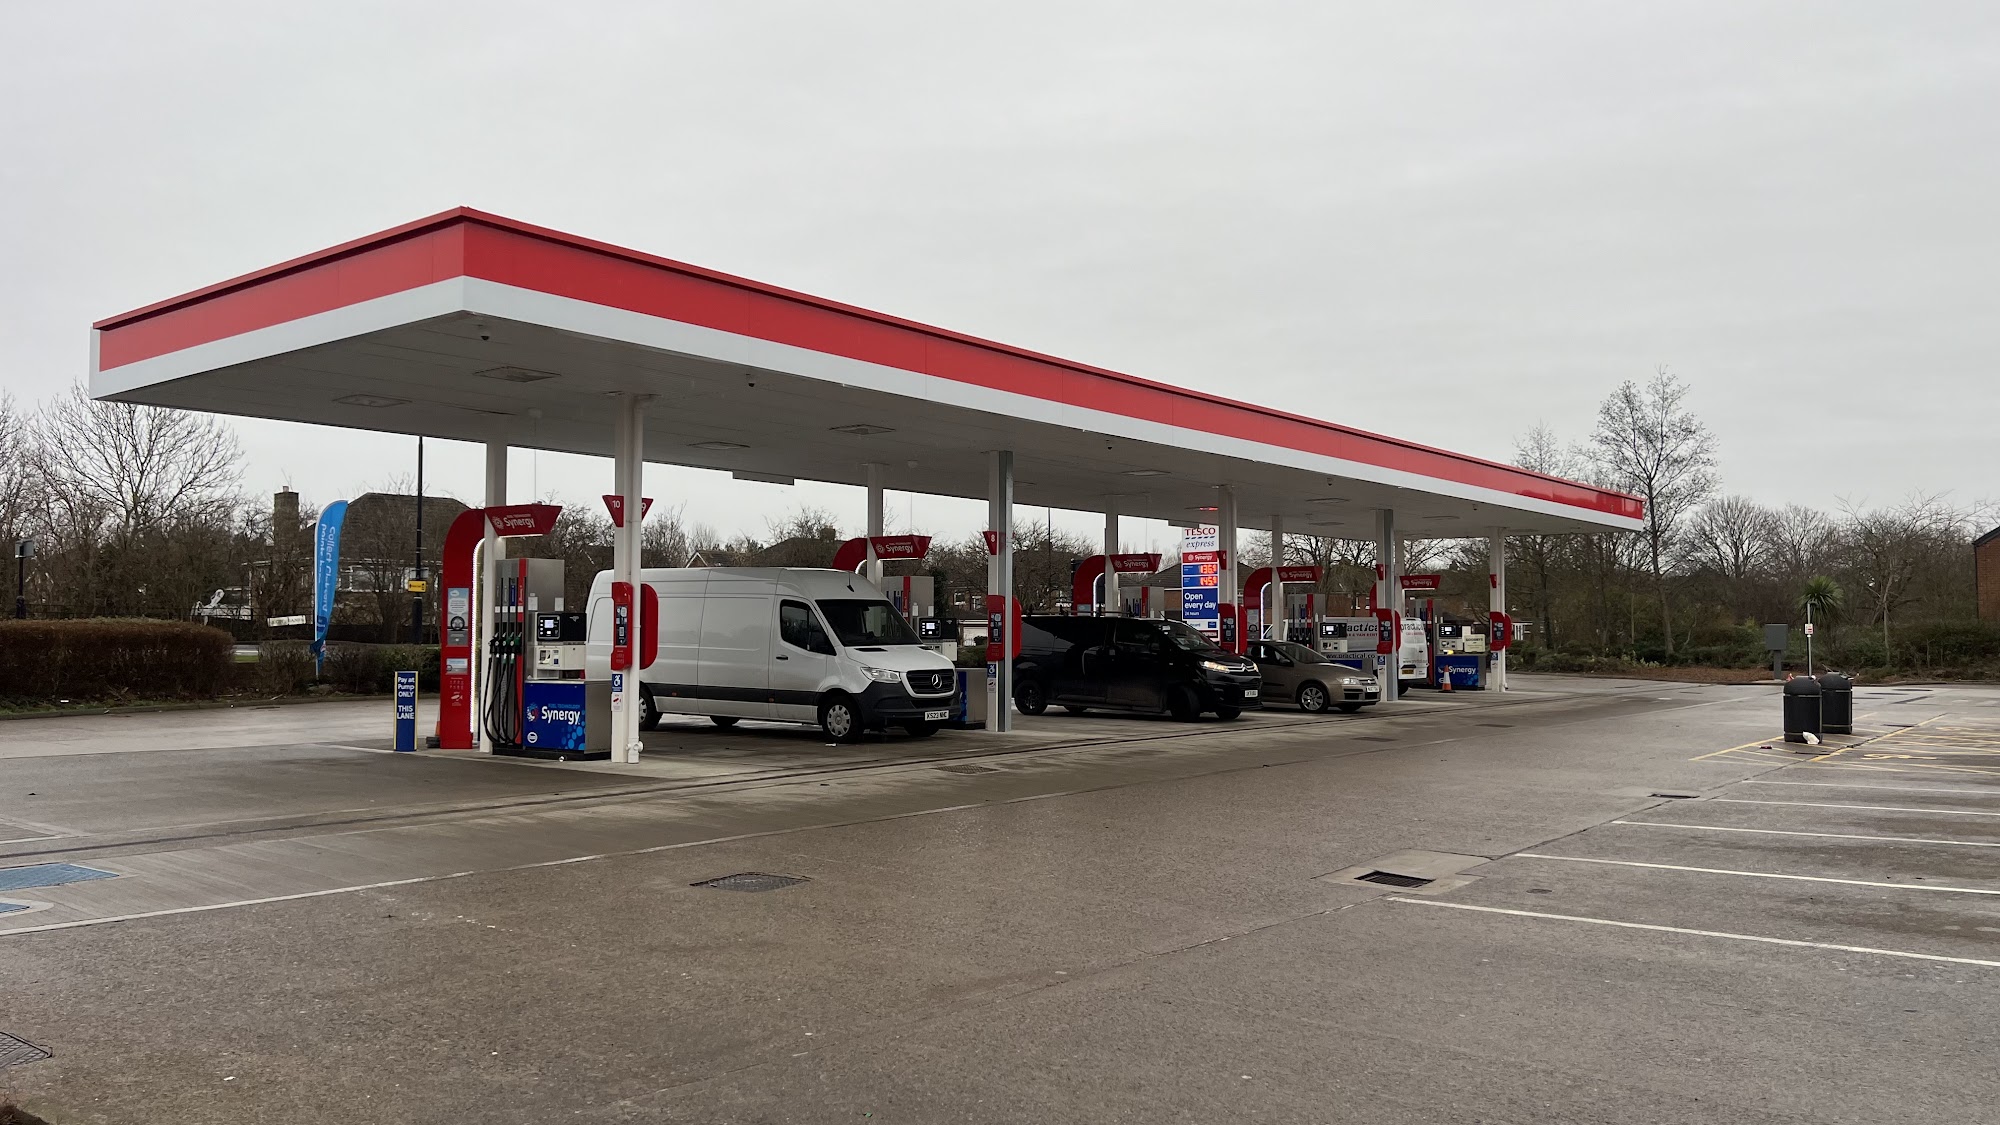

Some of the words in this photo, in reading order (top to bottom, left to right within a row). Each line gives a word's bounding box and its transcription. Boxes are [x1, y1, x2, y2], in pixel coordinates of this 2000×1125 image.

[612, 500, 621, 508] 10
[503, 517, 535, 529] Synergy
[1185, 528, 1216, 536] TESCO
[326, 526, 336, 563] Collect
[886, 544, 913, 554] Synergy
[1186, 540, 1214, 550] express
[1184, 592, 1204, 601] Open
[1184, 602, 1203, 610] every
[1204, 601, 1216, 610] day
[1448, 666, 1476, 674] Synergy
[542, 706, 580, 725] Synergy
